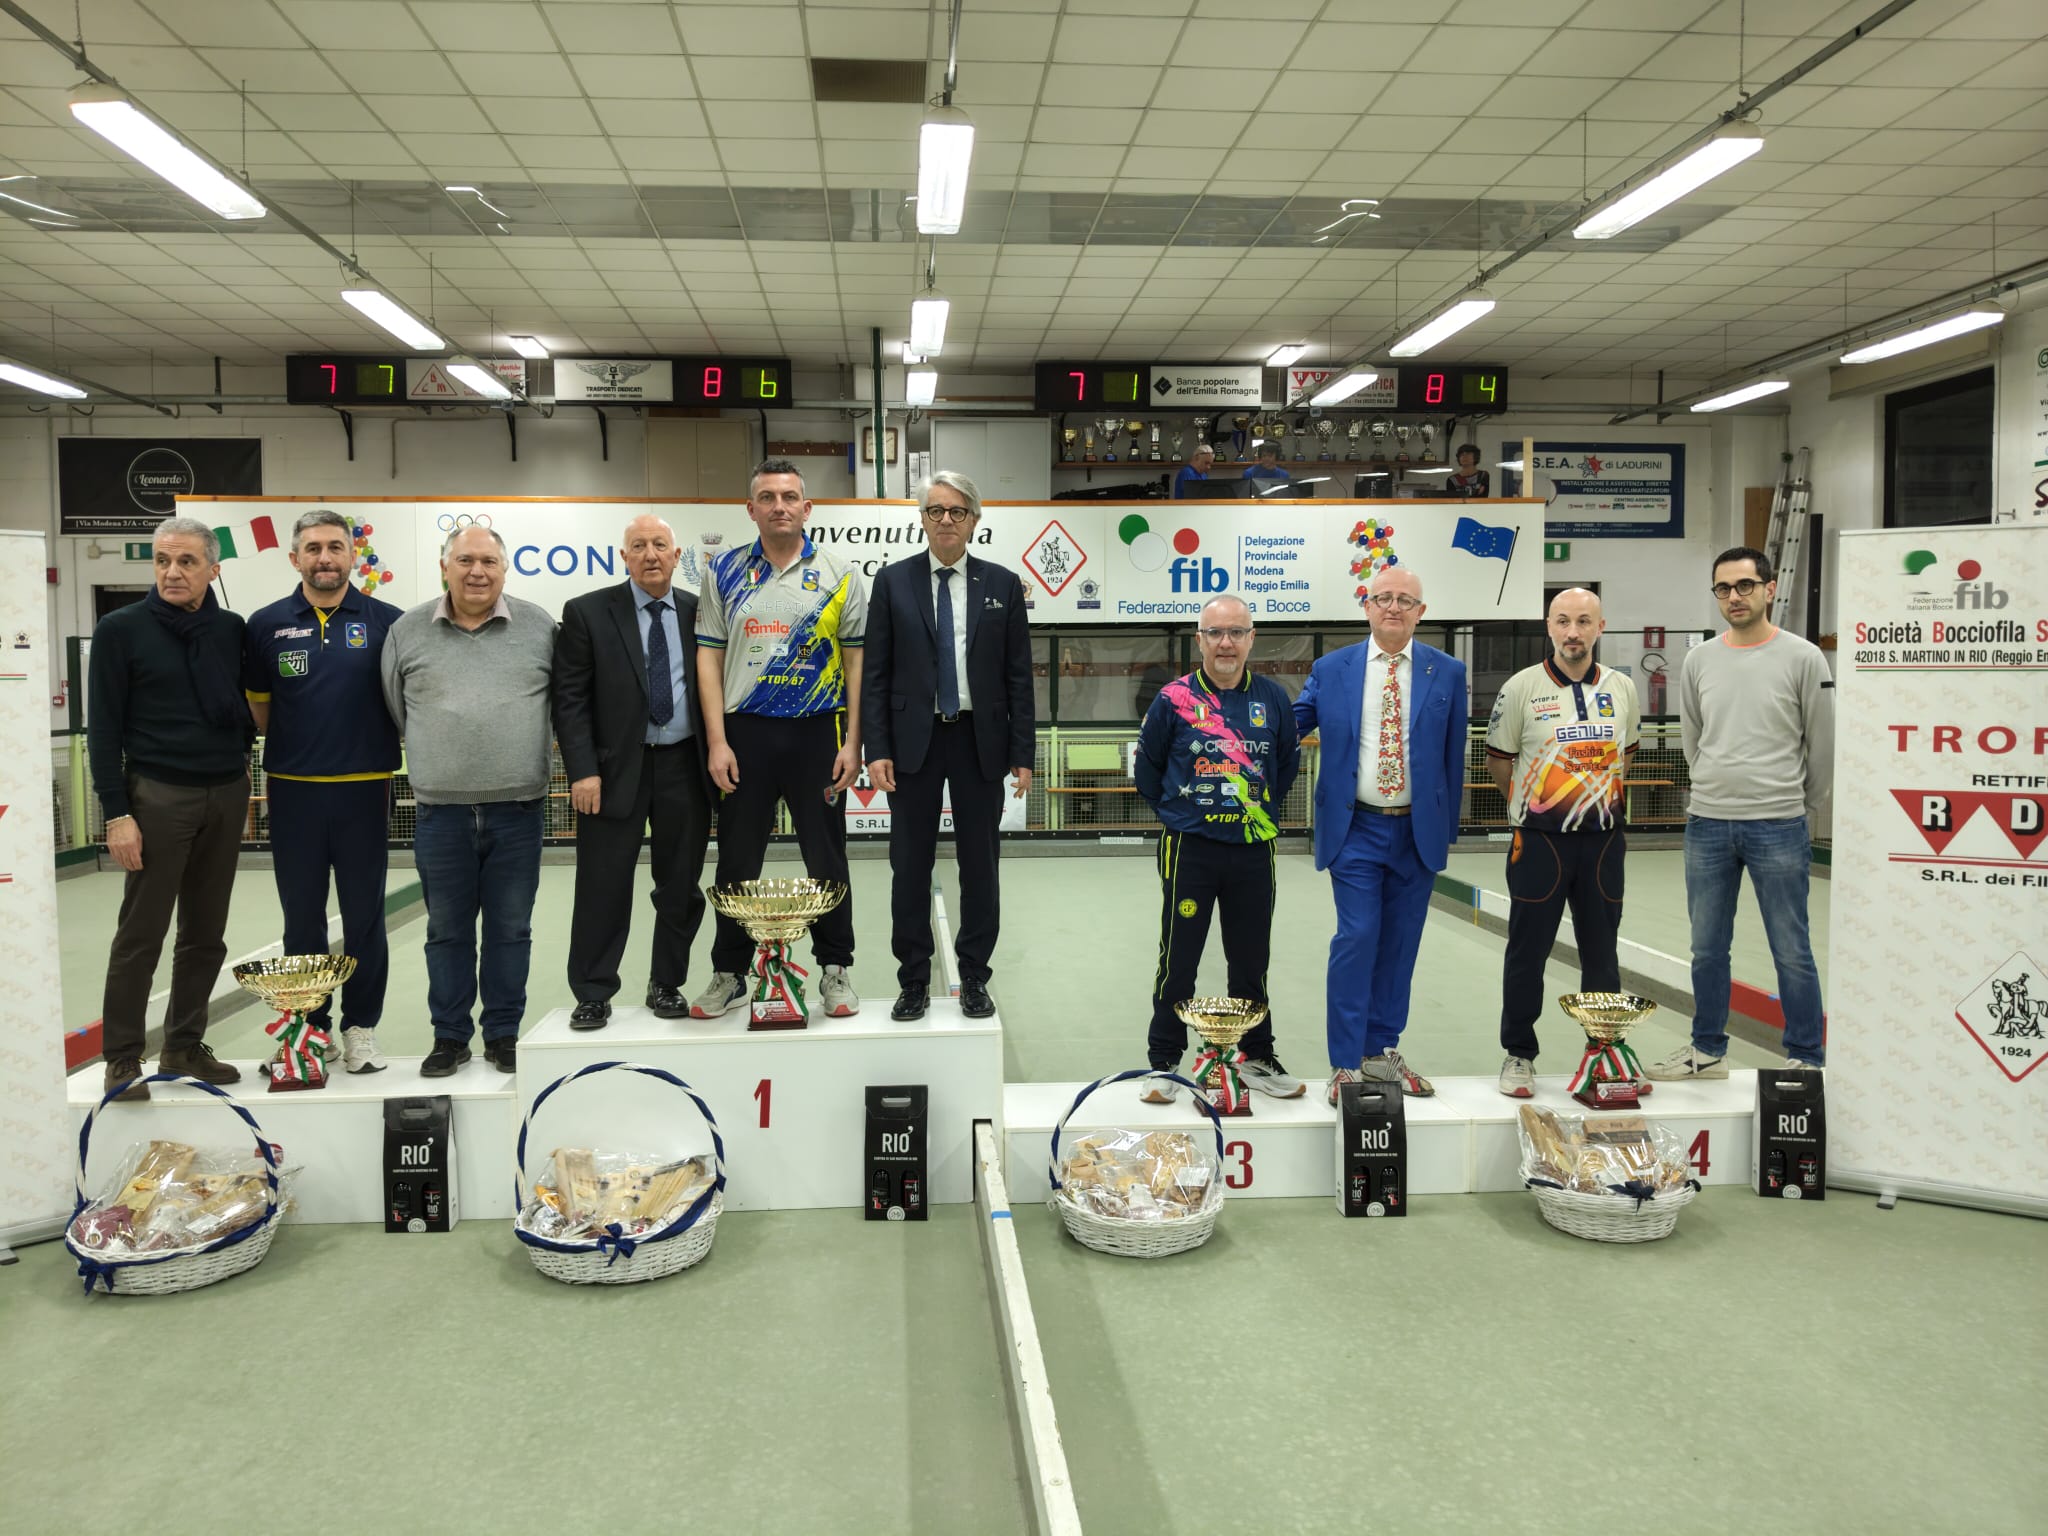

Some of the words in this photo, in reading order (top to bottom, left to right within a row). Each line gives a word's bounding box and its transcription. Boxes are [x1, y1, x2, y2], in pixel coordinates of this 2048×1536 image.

[320, 364, 337, 395] 7
[378, 365, 394, 394] 7
[703, 367, 722, 398] 8
[1069, 372, 1085, 401] 7
[1132, 373, 1138, 400] 1
[1176, 377, 1201, 386] Banca
[1203, 378, 1239, 388] popolare
[1176, 386, 1218, 396] dell'Emilia
[1220, 387, 1259, 397] Romagna
[1425, 374, 1445, 404] 8
[1480, 376, 1497, 403] 4
[1532, 457, 1574, 469] S.E.A.
[1605, 461, 1614, 470] di
[1616, 461, 1662, 470] LADURINI
[138, 473, 183, 487] Leonardo
[92, 519, 122, 527] Modena
[1245, 536, 1305, 548] Delegazione
[513, 545, 628, 577] CON
[1245, 551, 1298, 561] Provinciale
[1168, 556, 1230, 593] fib
[1244, 566, 1284, 576] Modena
[1046, 576, 1063, 584] 1924
[1244, 581, 1279, 593] Reggio
[1280, 581, 1310, 591] Emilia
[1954, 581, 2009, 610] fib
[1118, 600, 1201, 614] Federazione
[1266, 600, 1311, 613] Bocce
[744, 617, 790, 638] famila
[1855, 621, 1922, 644] Società
[1932, 620, 2025, 643] Bocciofila
[1855, 650, 1886, 663] 42018
[1888, 650, 1899, 663] S.
[1902, 650, 1950, 663] MARTINO
[1954, 650, 1965, 662] IN
[1969, 650, 1987, 663] RIO
[1991, 649, 2033, 665] (Reggio
[767, 675, 789, 685] TOP
[1555, 726, 1614, 739] GENIUS
[1204, 740, 1269, 755] CREATIVE
[1194, 757, 1241, 776] famila
[1218, 814, 1240, 823] TOP
[1921, 795, 1953, 833] R
[2010, 798, 2045, 836] D
[1921, 869, 1979, 884] S.R.L.
[1985, 873, 2016, 886] dei
[2000, 1045, 2032, 1058] 1924
[754, 1079, 771, 1129] 1
[1688, 1130, 1711, 1177] 4
[1224, 1140, 1254, 1189] 3
